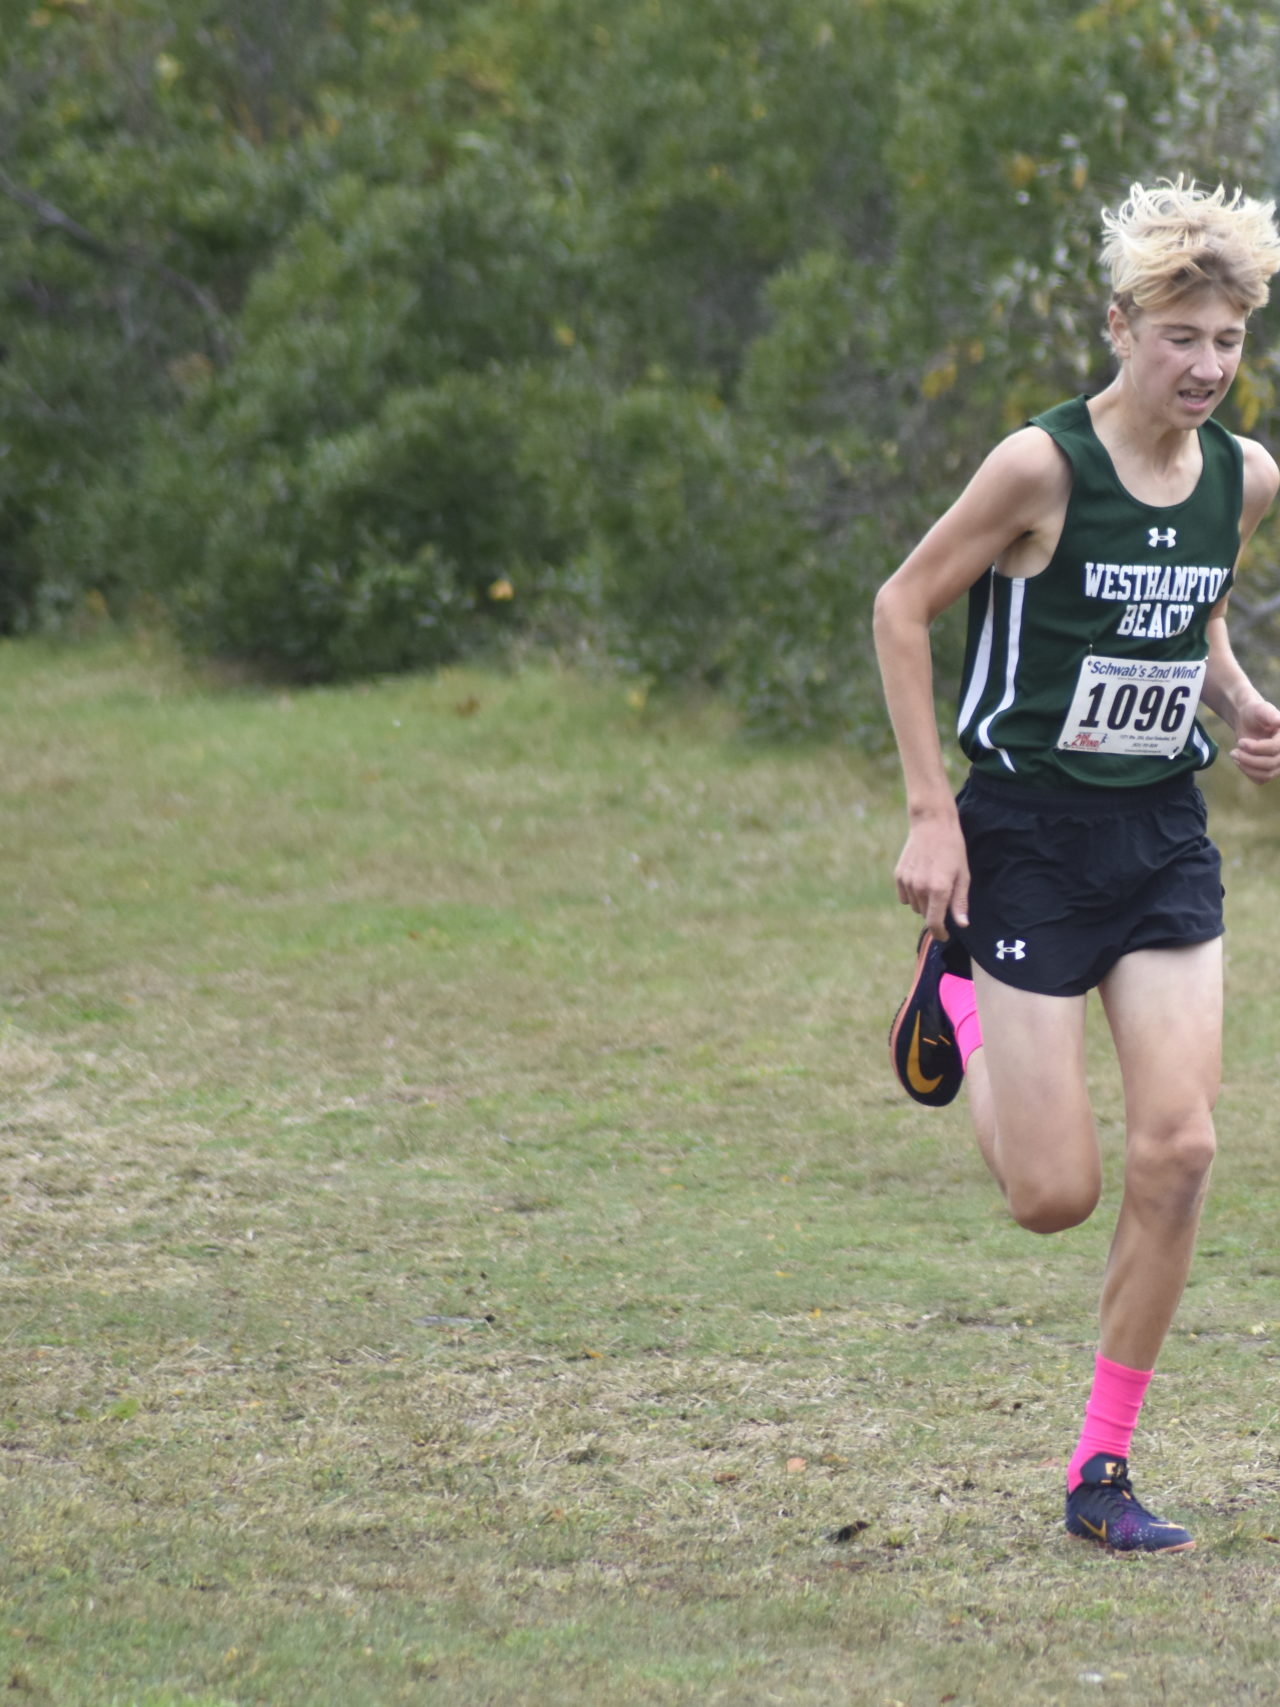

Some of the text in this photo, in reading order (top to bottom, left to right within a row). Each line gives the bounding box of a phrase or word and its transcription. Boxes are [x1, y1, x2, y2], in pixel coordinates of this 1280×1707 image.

[1116, 603, 1194, 638] BEACH
[1090, 661, 1199, 679] Schwab's 2nd Wind
[1078, 682, 1191, 733] 1096
